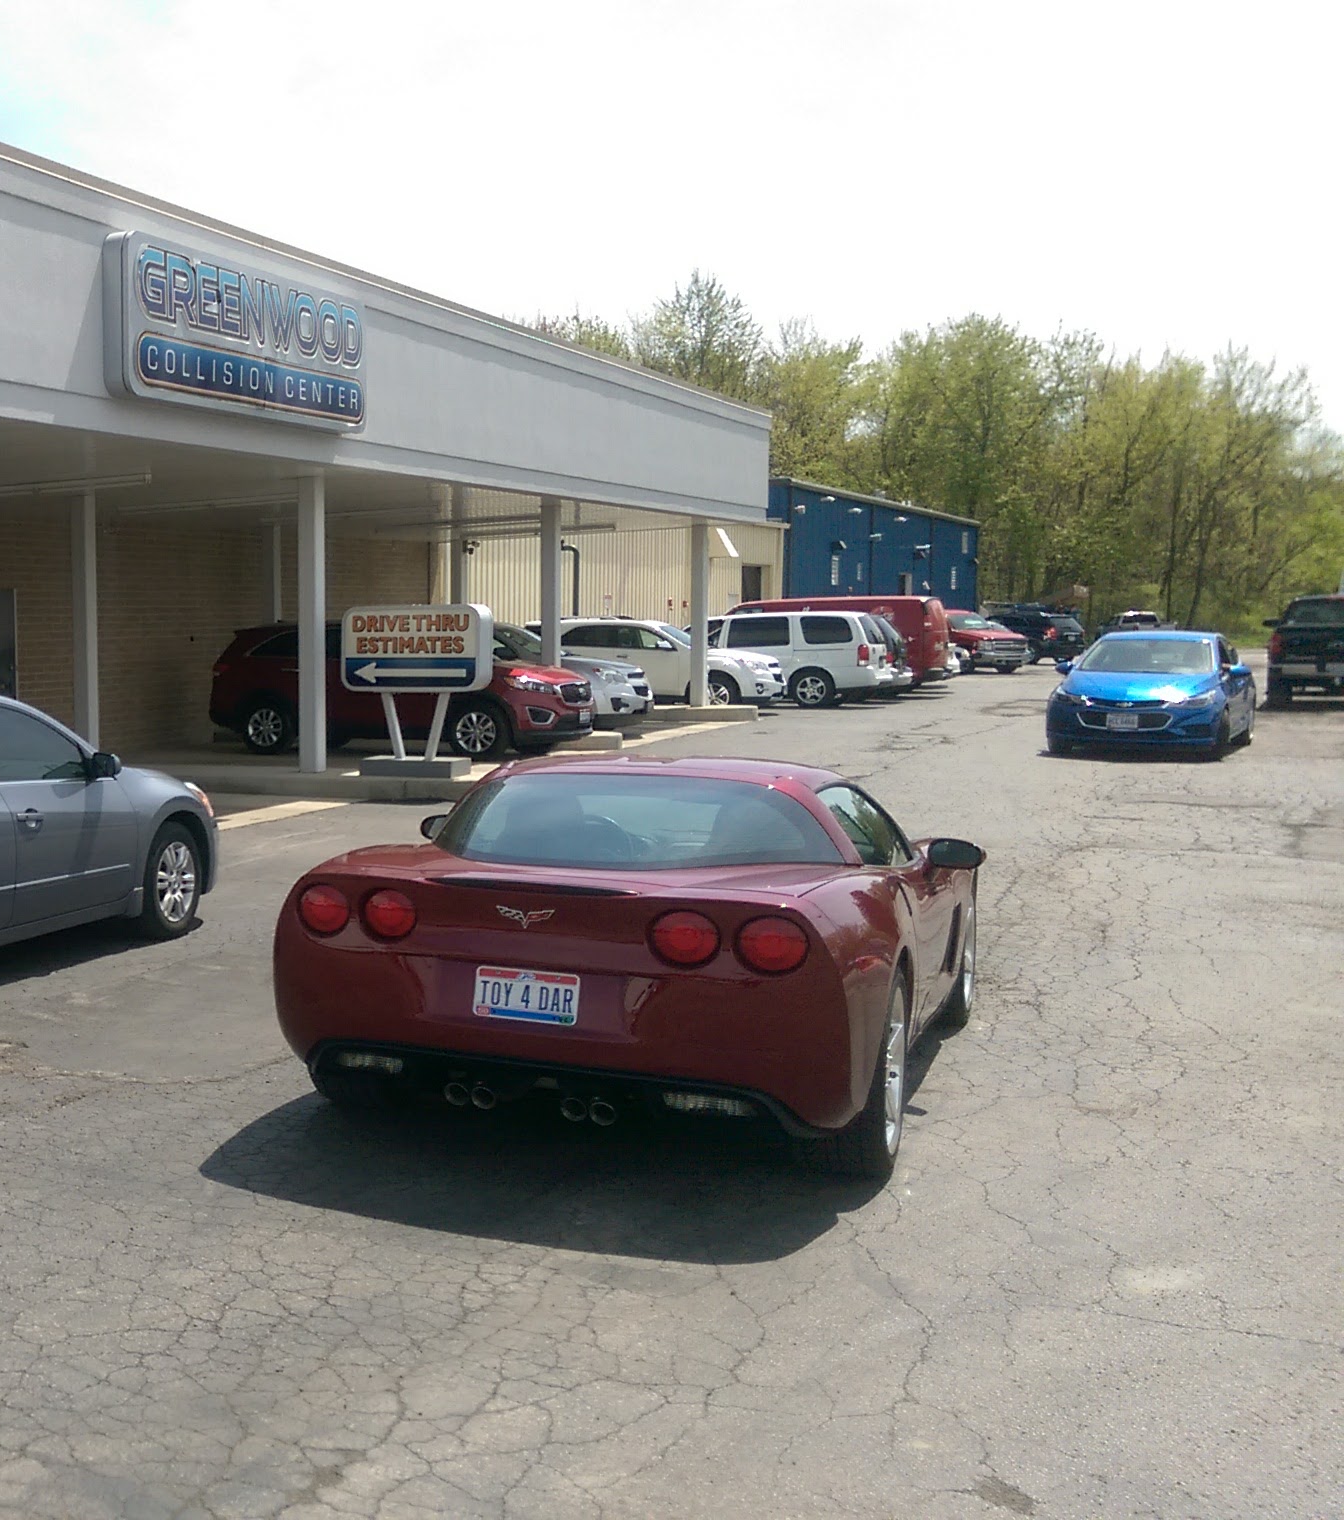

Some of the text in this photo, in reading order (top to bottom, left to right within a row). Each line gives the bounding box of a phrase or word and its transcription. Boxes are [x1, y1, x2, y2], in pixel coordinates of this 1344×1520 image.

[138, 245, 363, 369] GREENWOOD
[147, 345, 358, 410] COLLISION CENTER
[352, 614, 470, 632] DRIVE THRU
[356, 636, 464, 654] ESTIMATES
[480, 980, 574, 1013] TOY 4 DAR
